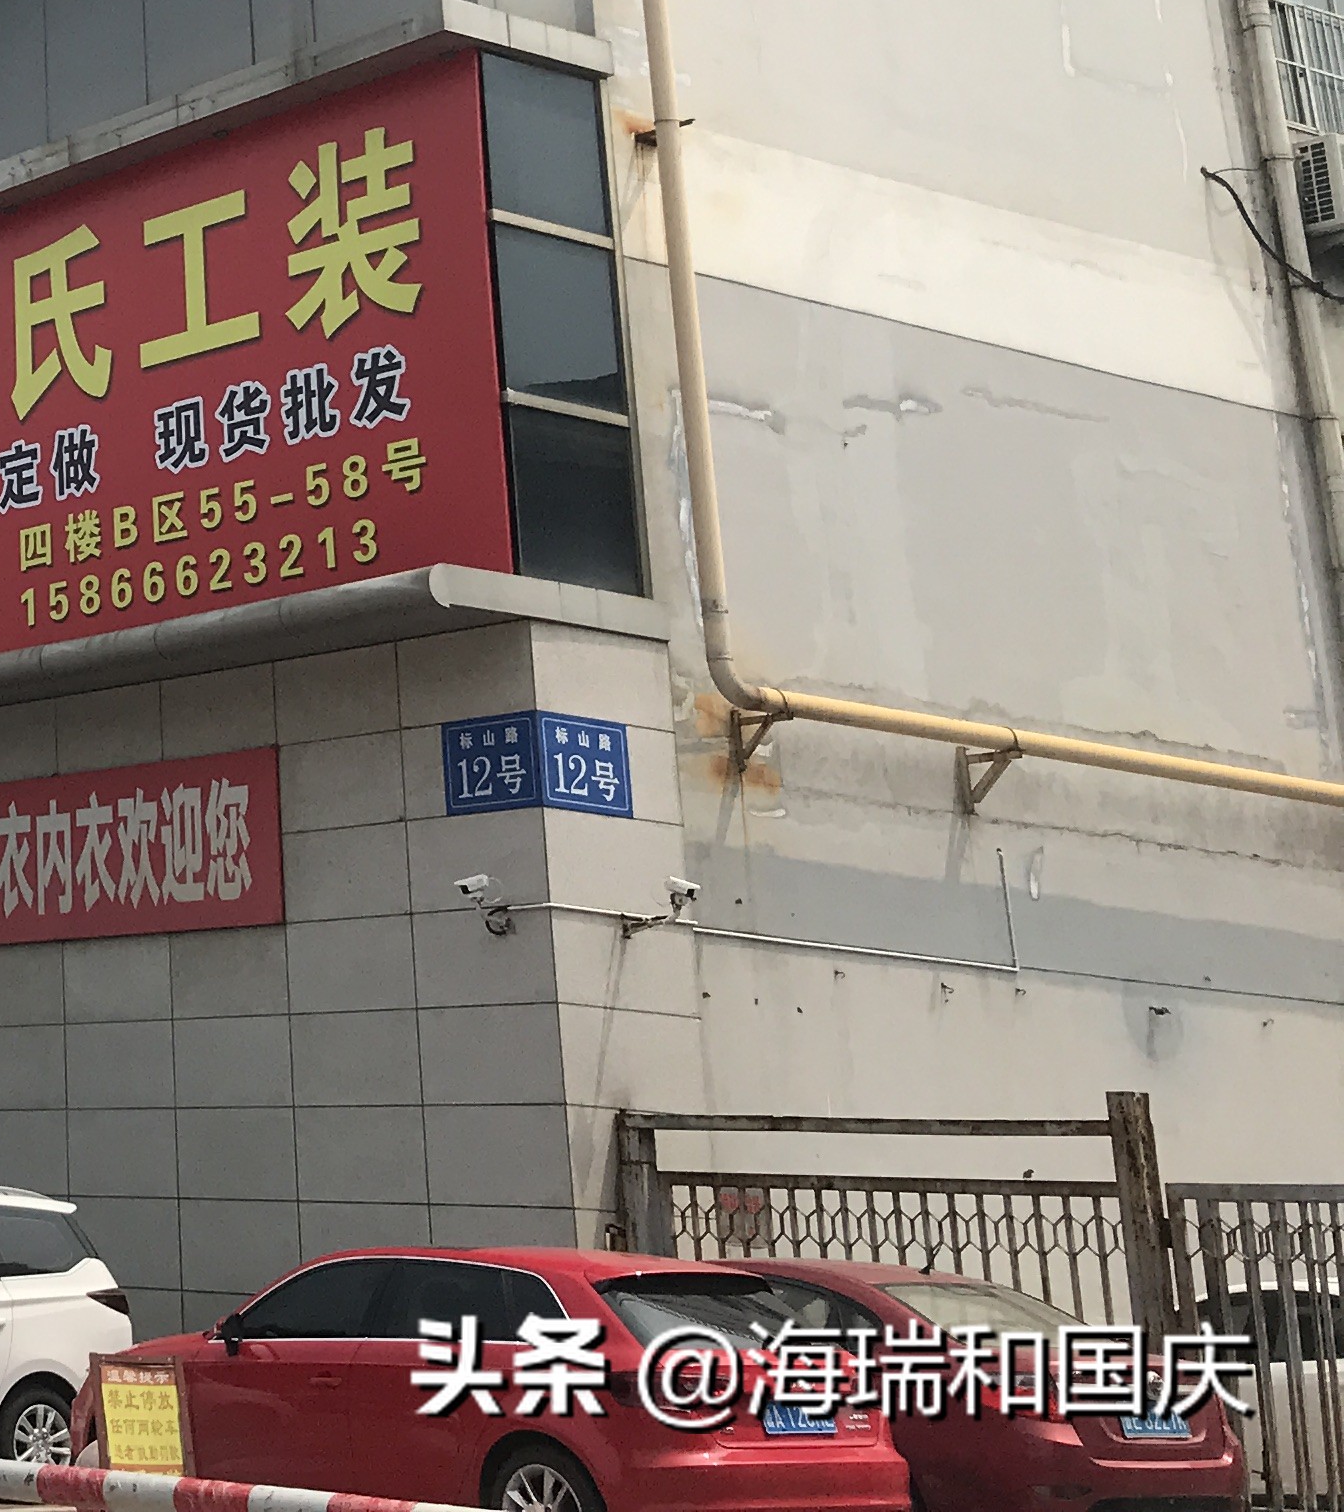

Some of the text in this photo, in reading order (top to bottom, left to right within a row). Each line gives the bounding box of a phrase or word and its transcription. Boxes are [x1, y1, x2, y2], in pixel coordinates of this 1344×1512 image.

[153, 344, 411, 474] 现货批发
[19, 437, 428, 573] 四楼B区55-58号
[19, 518, 380, 628] 15866623213
[459, 726, 518, 750] 标山路
[555, 726, 611, 752] 标山路
[457, 753, 527, 799] 12号
[553, 752, 620, 802] 12号
[108, 1390, 174, 1411] 禁止停放
